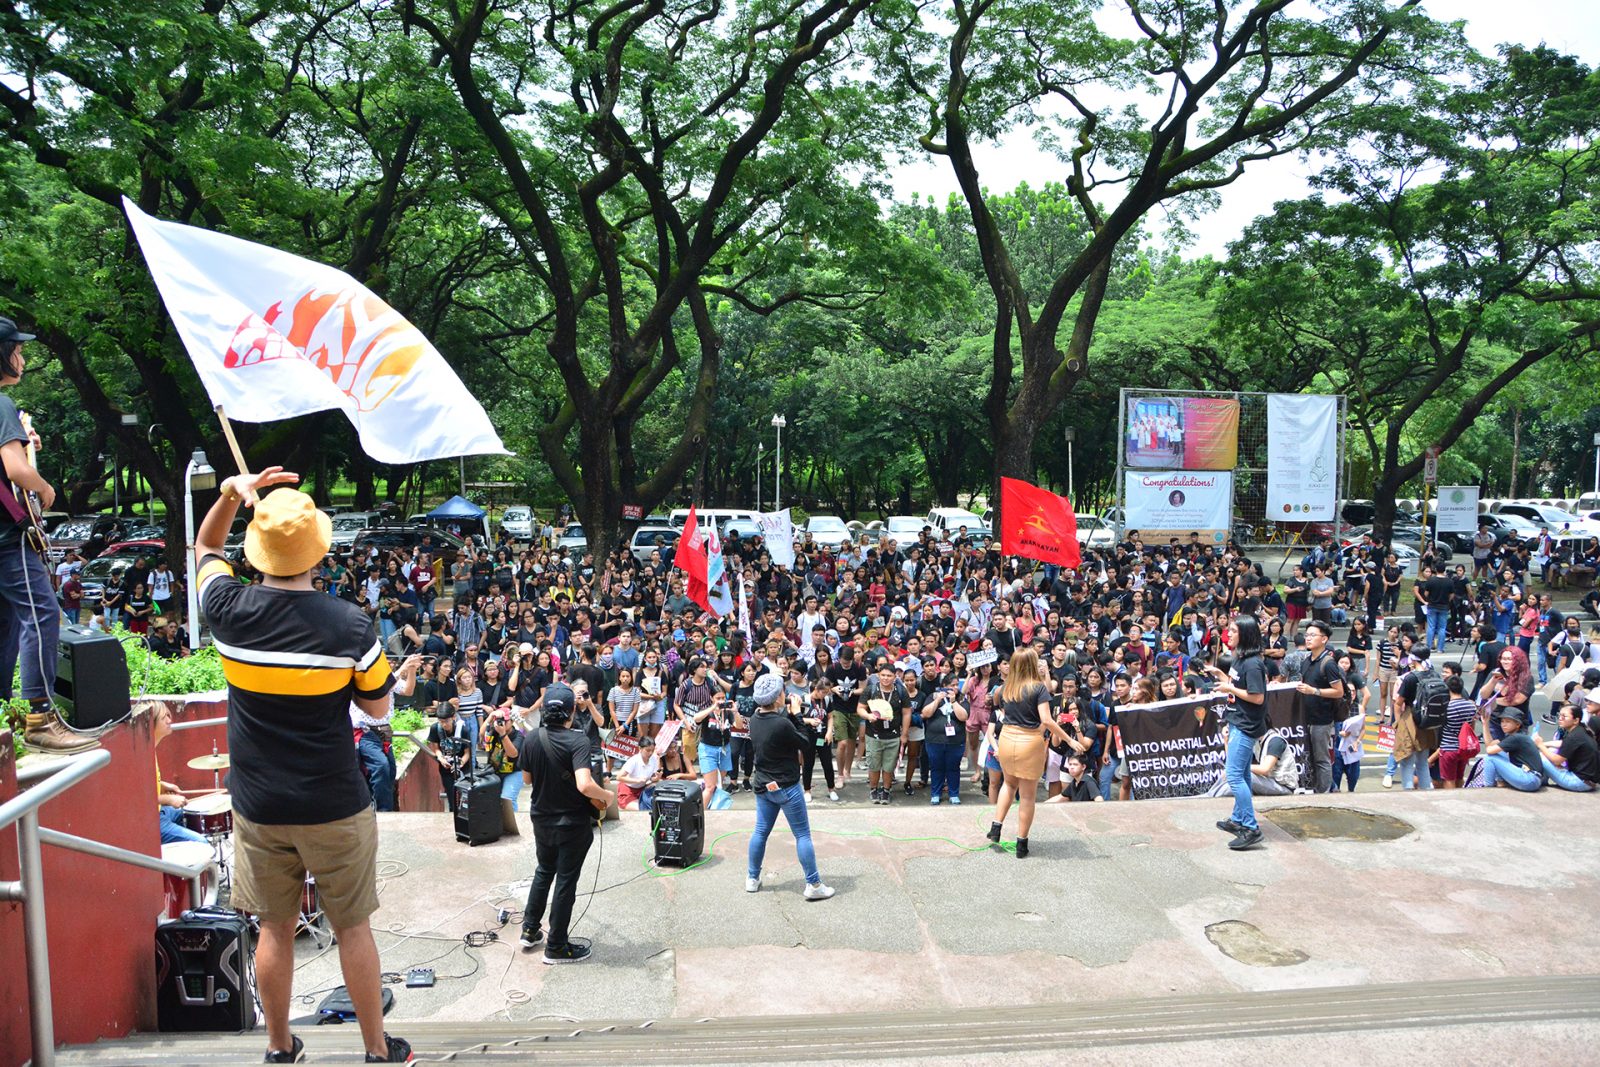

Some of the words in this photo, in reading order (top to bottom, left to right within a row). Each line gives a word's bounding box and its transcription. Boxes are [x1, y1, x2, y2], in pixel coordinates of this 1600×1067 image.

[1143, 475, 1215, 490] Congratulations!
[1125, 744, 1141, 755] NO
[1142, 741, 1158, 754] TO
[1161, 737, 1206, 752] MARTIAL
[1128, 756, 1178, 773] DEFEND
[1132, 777, 1150, 789] NO
[1151, 775, 1168, 787] TO
[1169, 770, 1209, 786] CAMPUS
